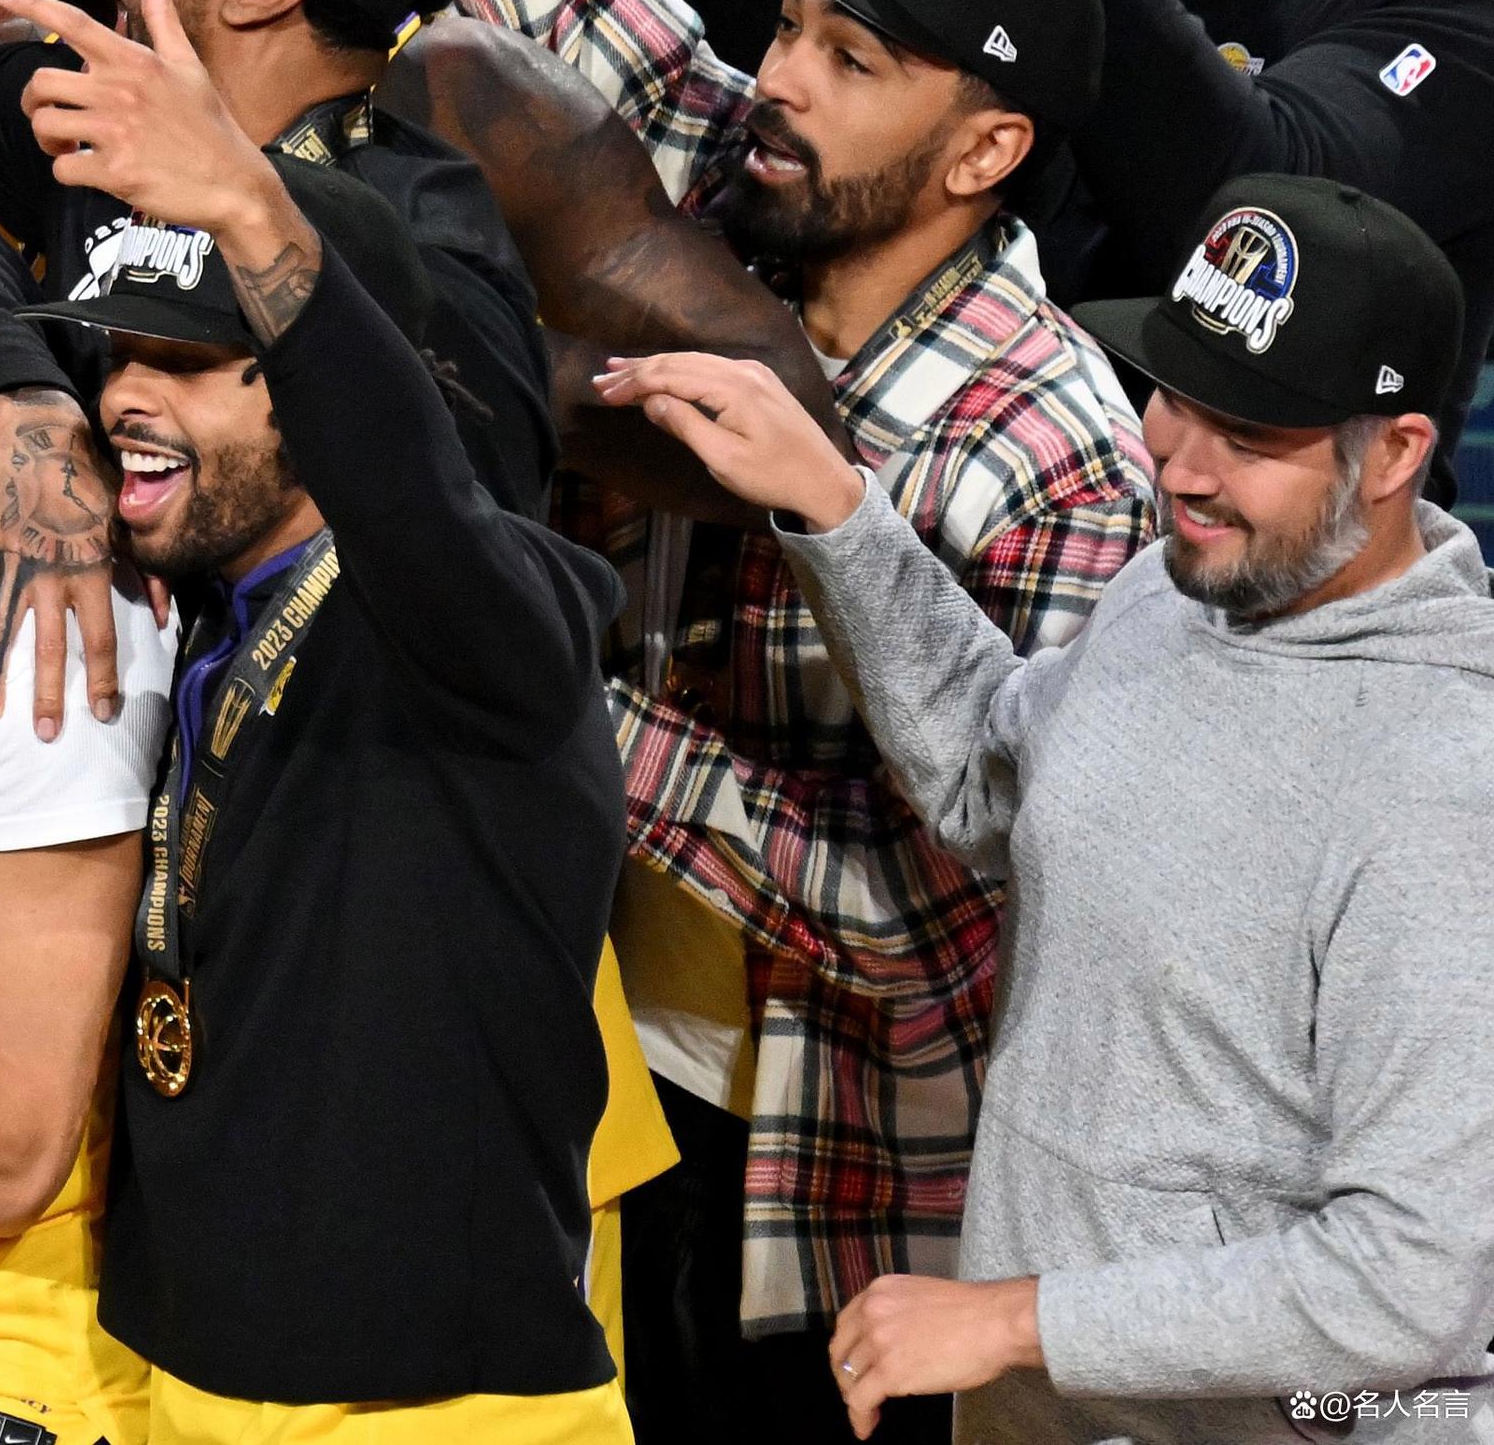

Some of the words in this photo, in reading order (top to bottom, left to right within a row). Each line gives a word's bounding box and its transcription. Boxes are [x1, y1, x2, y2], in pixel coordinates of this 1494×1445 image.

[251, 622, 294, 672] 2023
[149, 794, 171, 842] 2023
[178, 787, 218, 890] TOURNAMENT
[146, 845, 169, 952] CHAMPIONS
